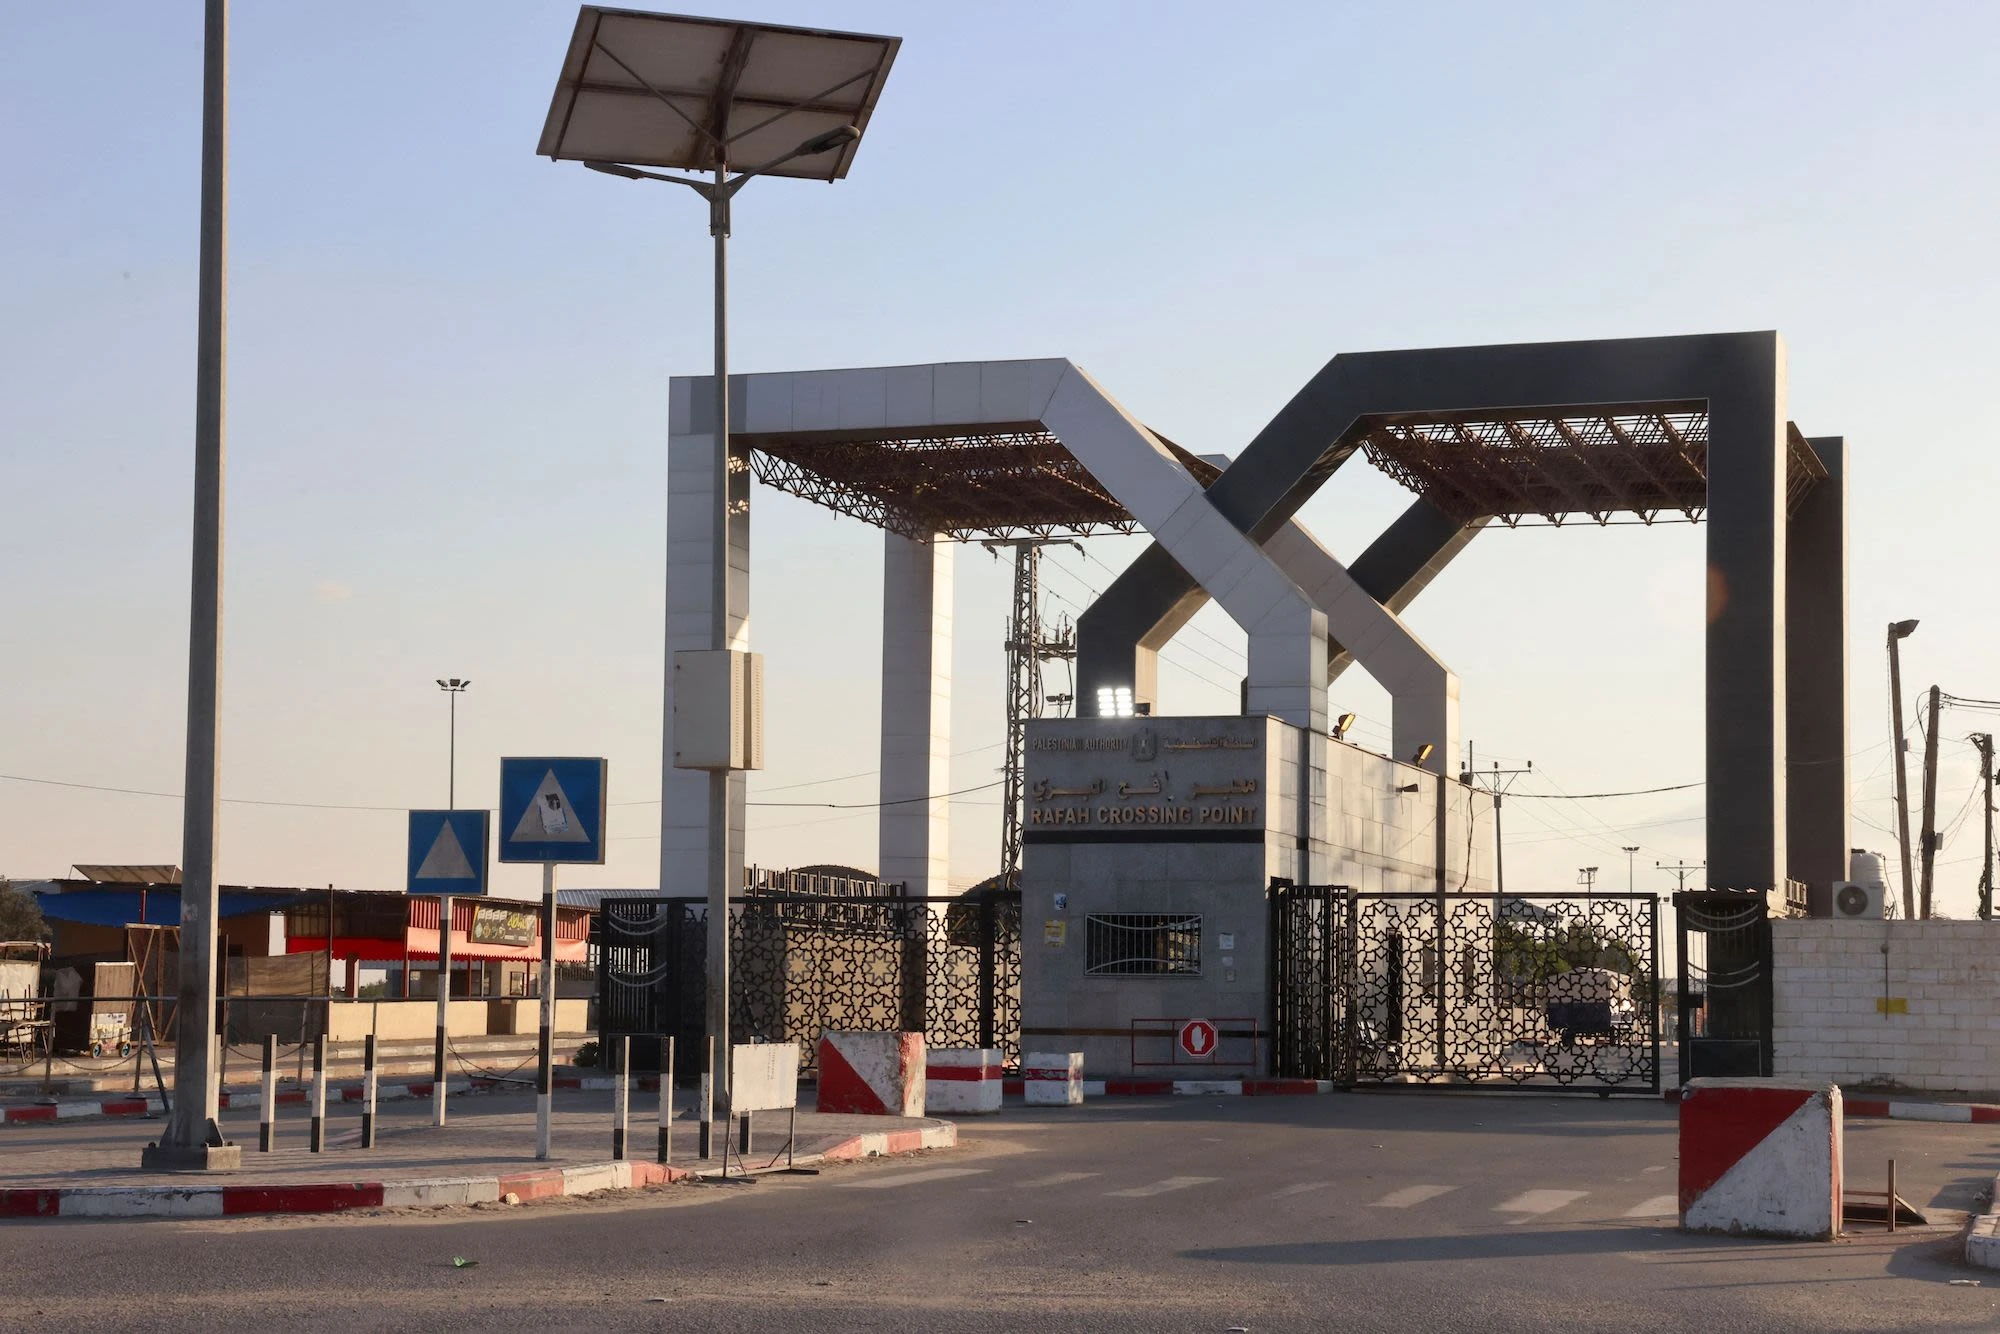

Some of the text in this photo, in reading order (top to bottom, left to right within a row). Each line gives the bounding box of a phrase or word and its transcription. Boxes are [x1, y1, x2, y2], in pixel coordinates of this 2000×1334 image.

[1084, 736, 1129, 752] AUTHORITY
[1189, 779, 1257, 801] معبر
[1031, 806, 1257, 825] RAFAH CROSSING POINT
